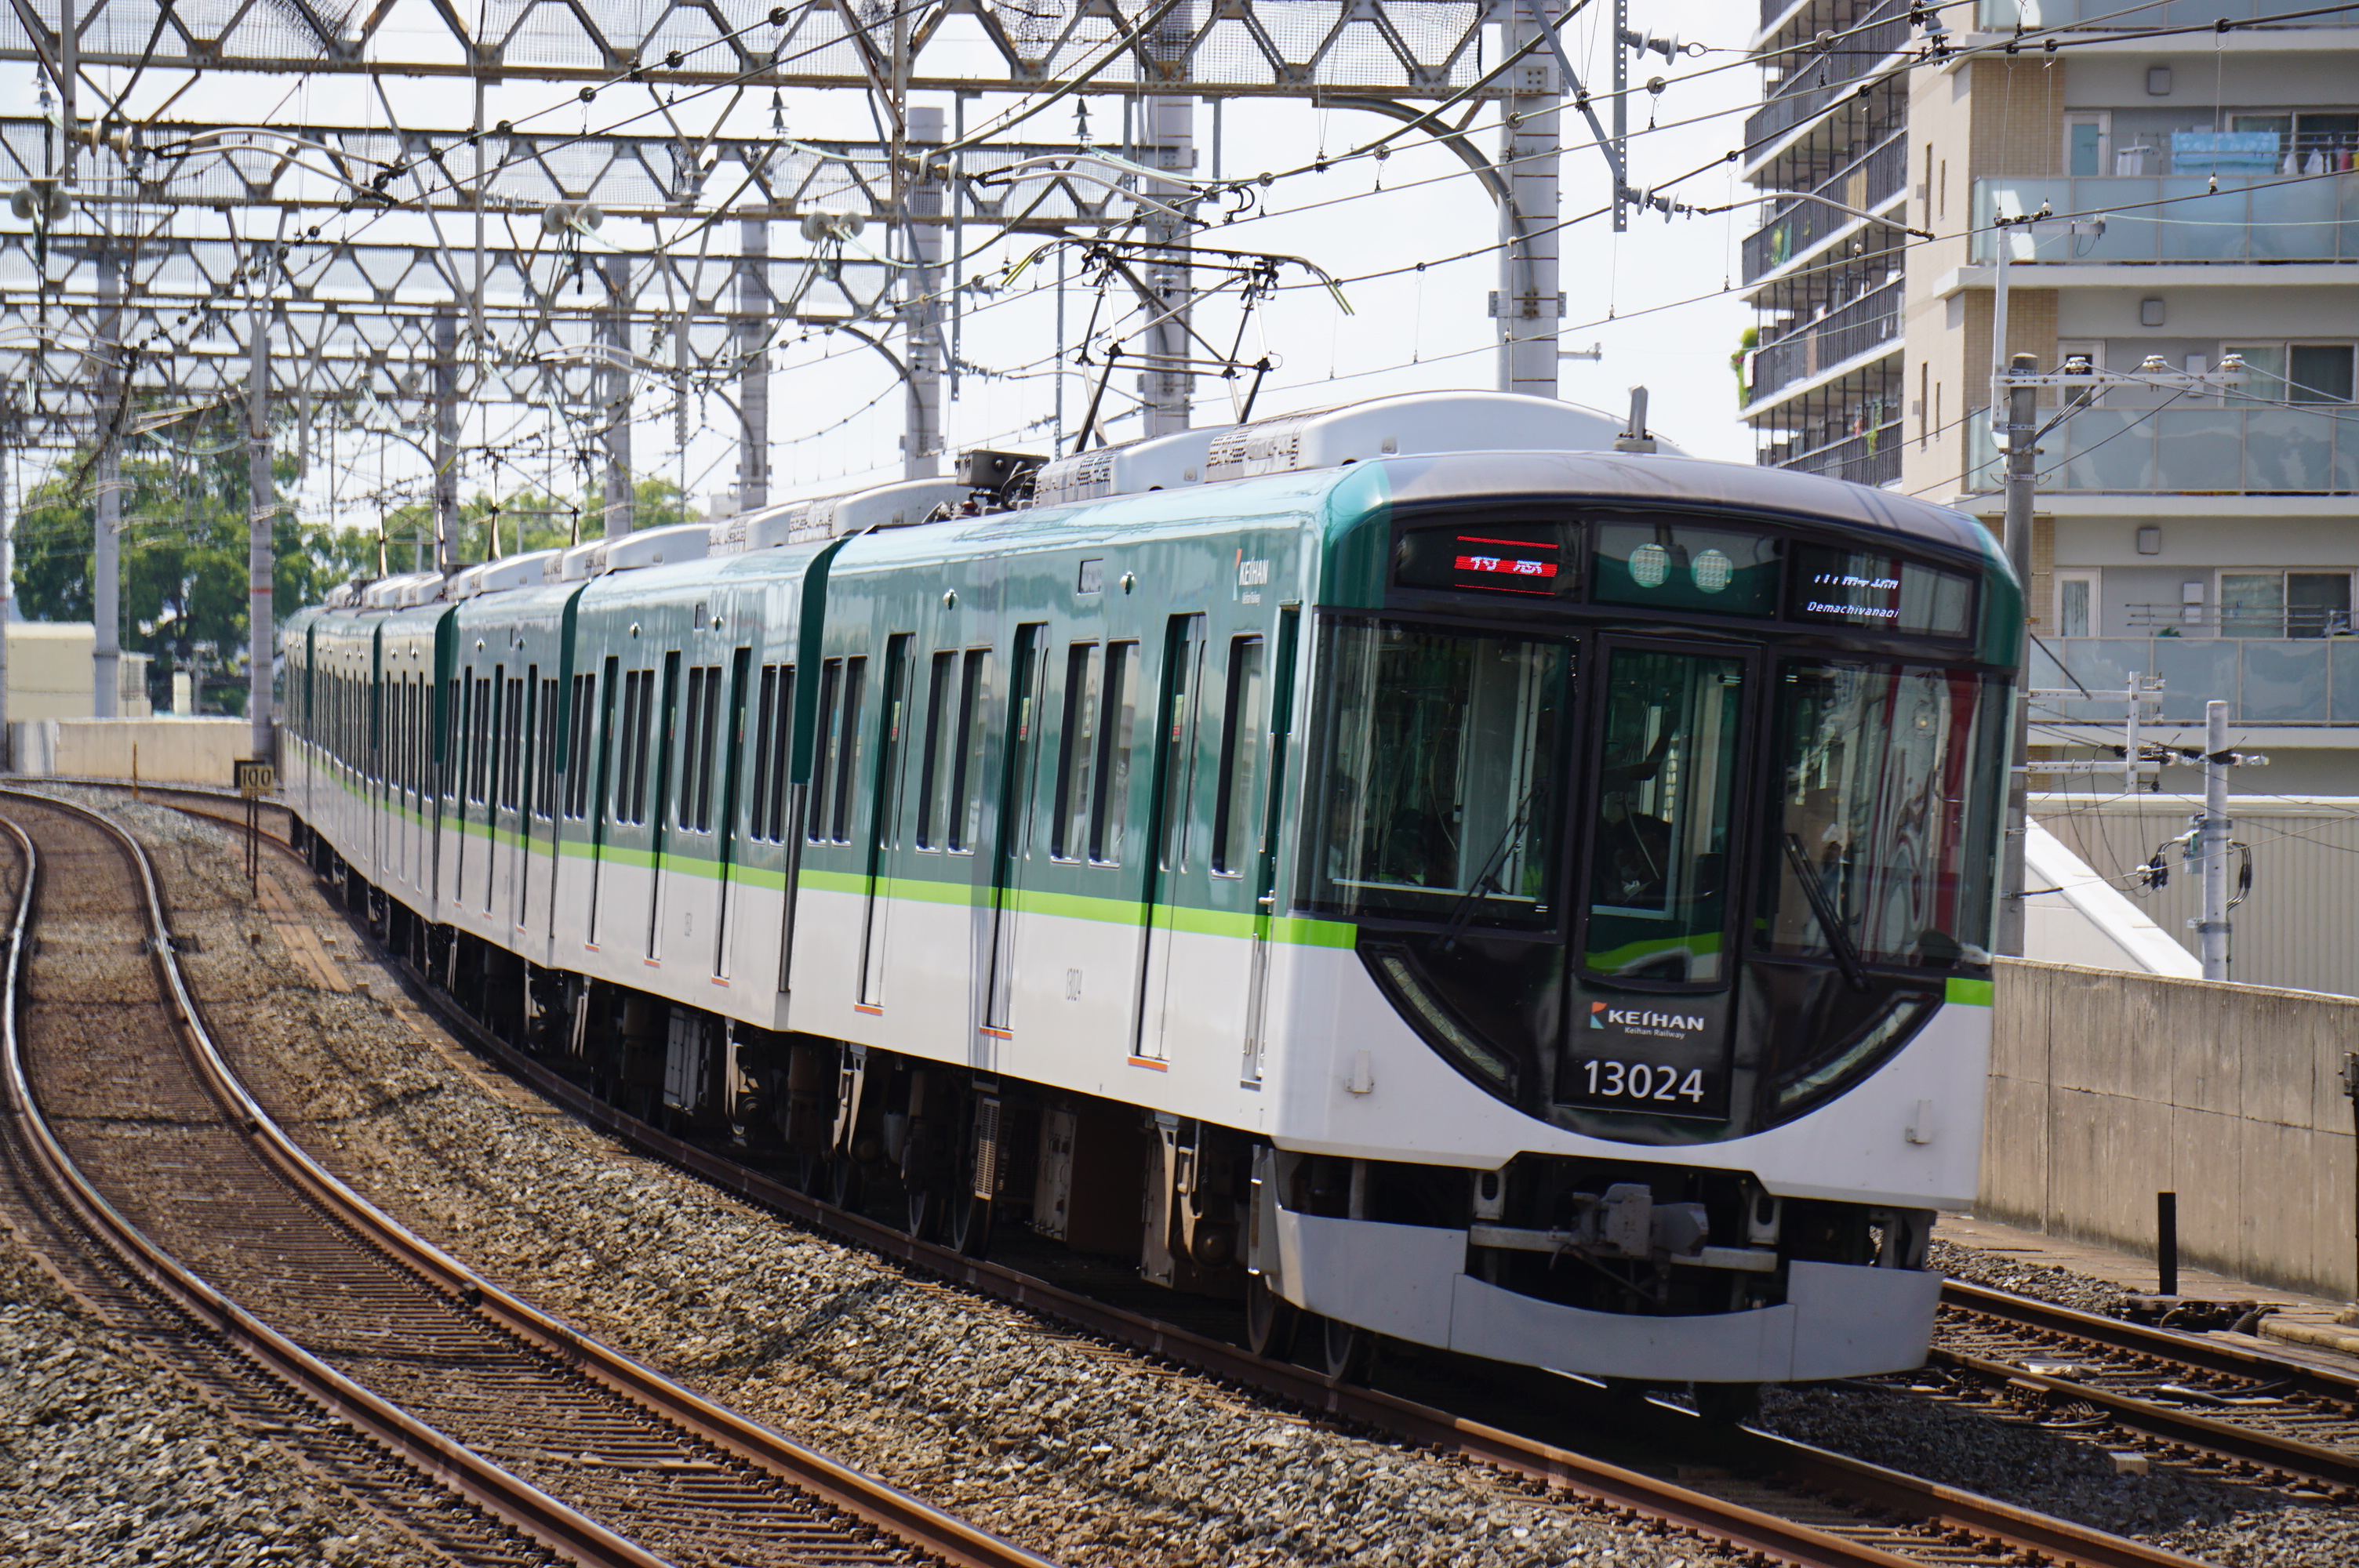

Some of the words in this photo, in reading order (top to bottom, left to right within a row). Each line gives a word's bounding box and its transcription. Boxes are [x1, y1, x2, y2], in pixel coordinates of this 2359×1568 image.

[1238, 556, 1269, 586] KEIHAN
[242, 768, 271, 787] 100
[1608, 1009, 1705, 1031] KEIHAN
[1624, 1026, 1652, 1036] Keihan
[1653, 1029, 1686, 1040] Railway
[1584, 1060, 1705, 1102] 13024
